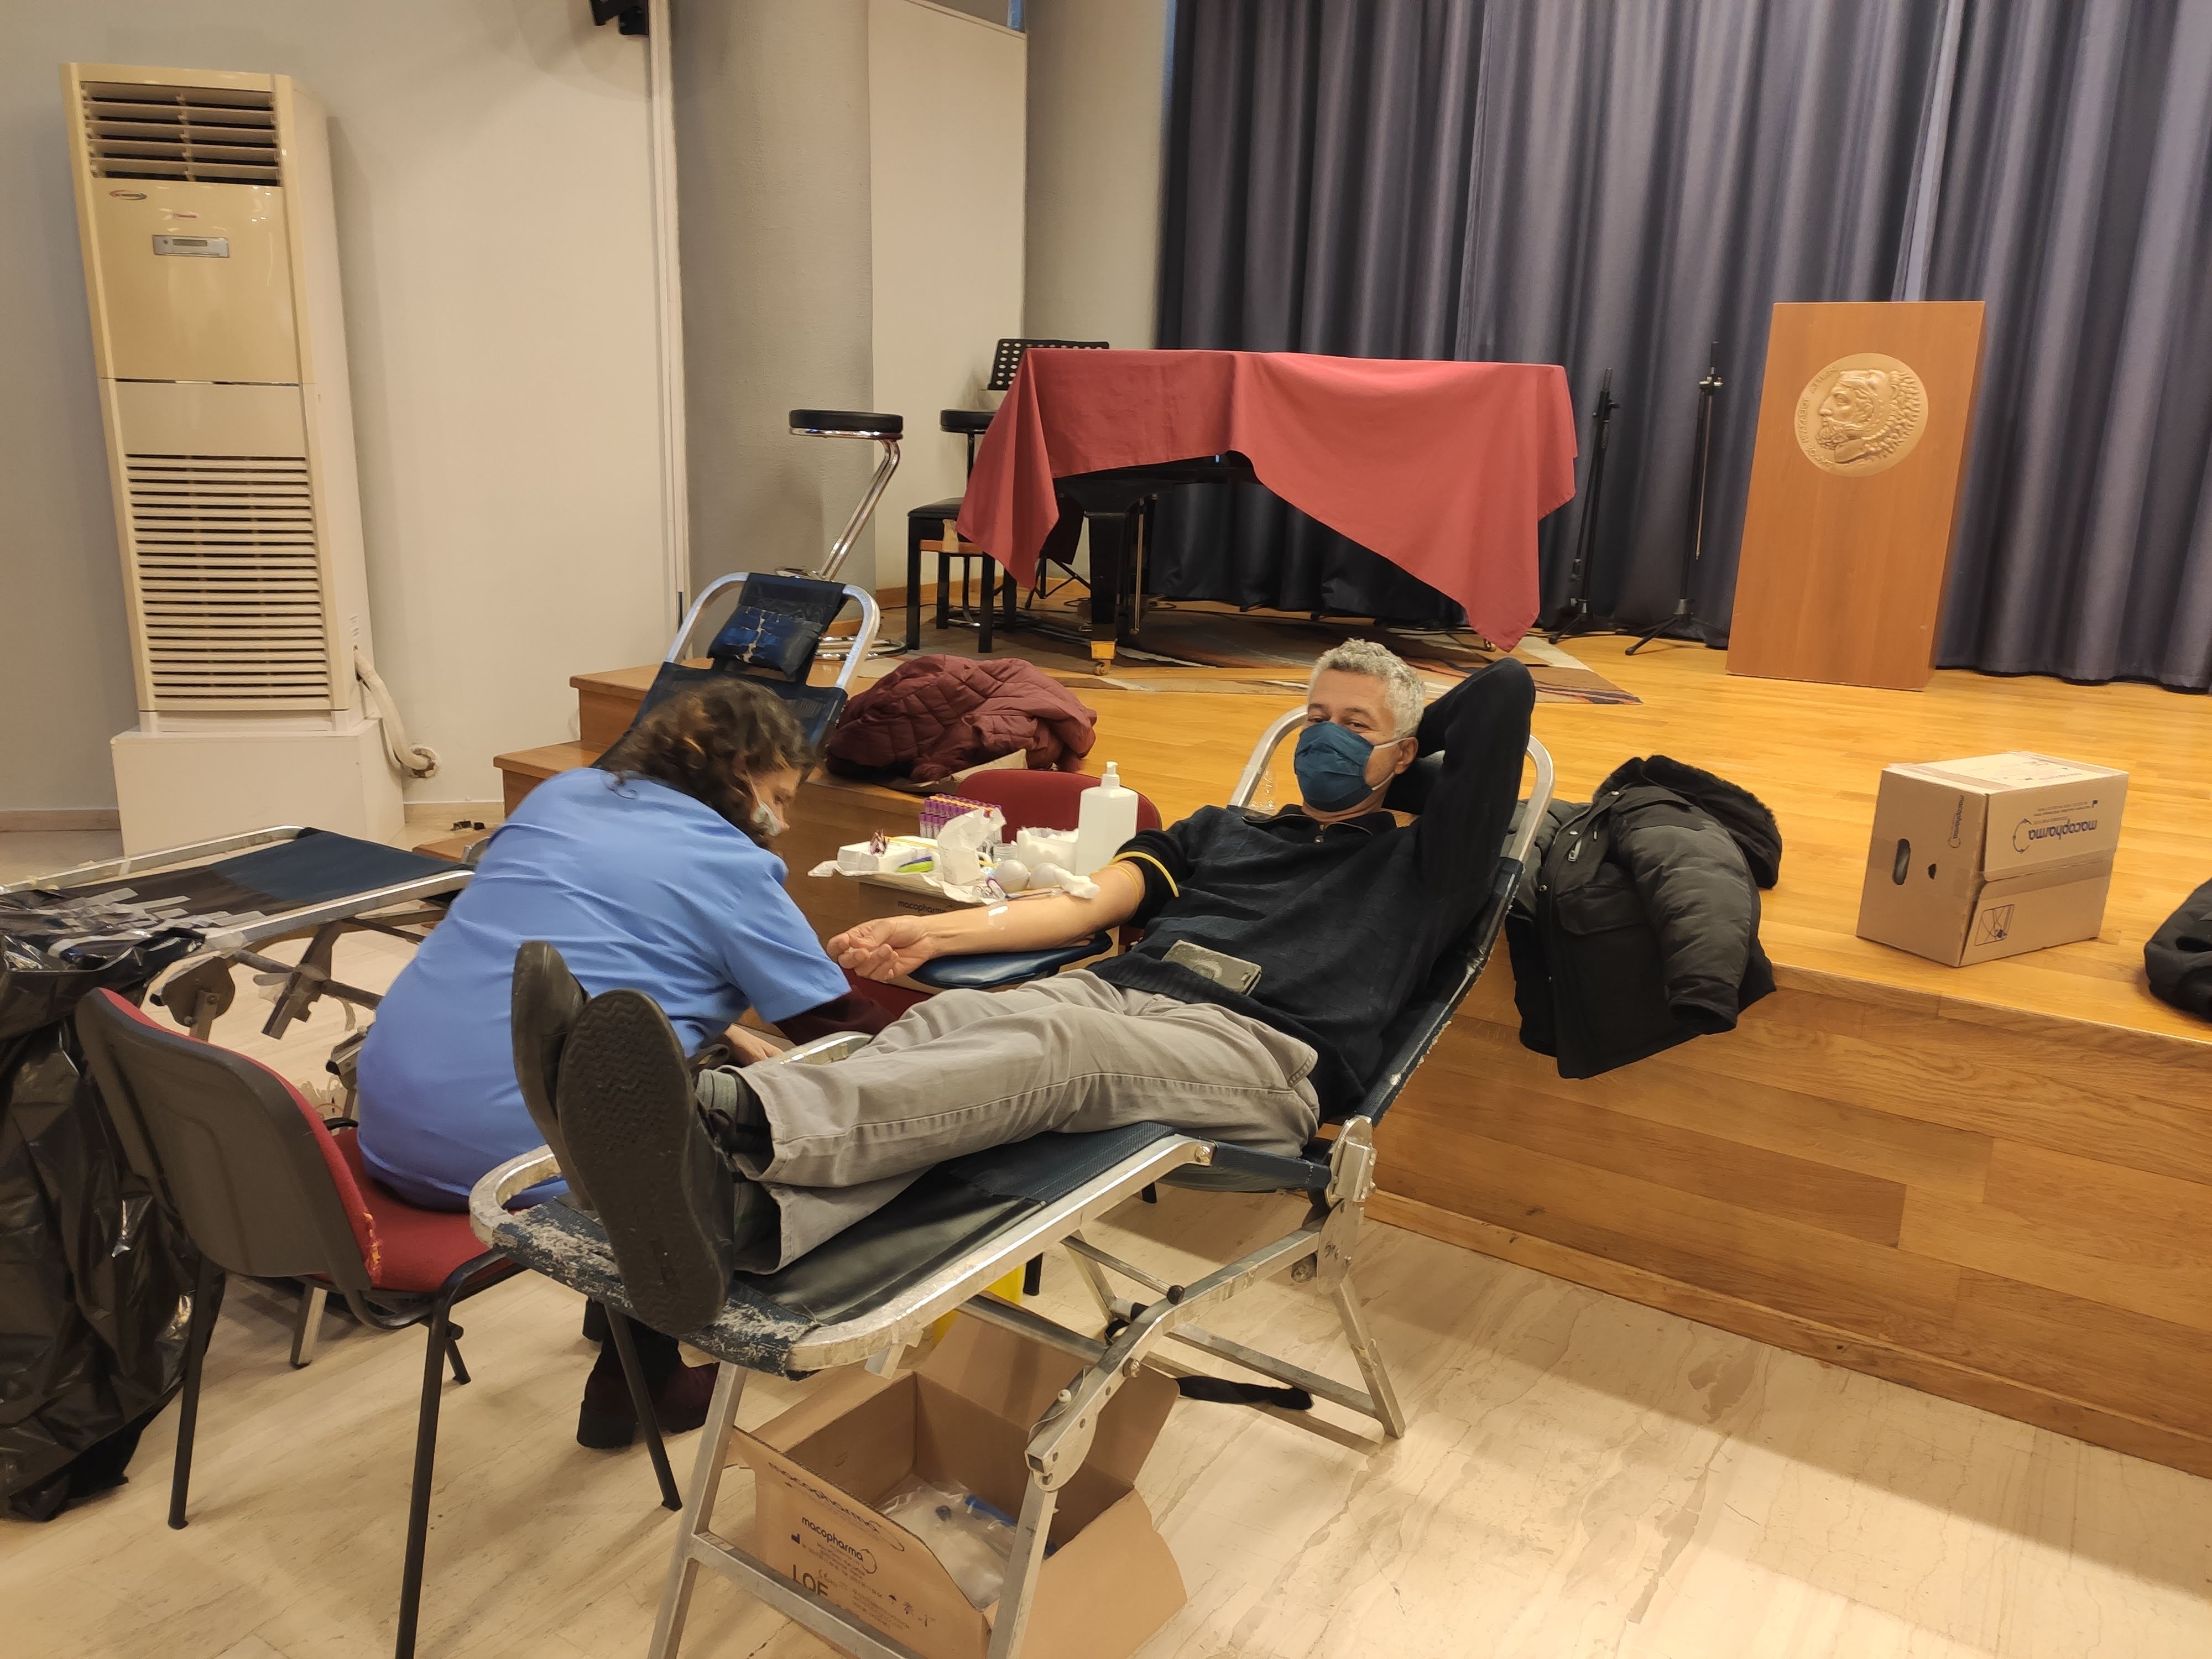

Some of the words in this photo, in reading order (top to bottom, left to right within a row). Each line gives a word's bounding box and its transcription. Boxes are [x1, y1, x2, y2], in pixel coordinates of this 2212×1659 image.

[1953, 795, 1965, 839] macopharma
[2028, 818, 2098, 841] macopharma
[802, 1517, 864, 1562] macopharma
